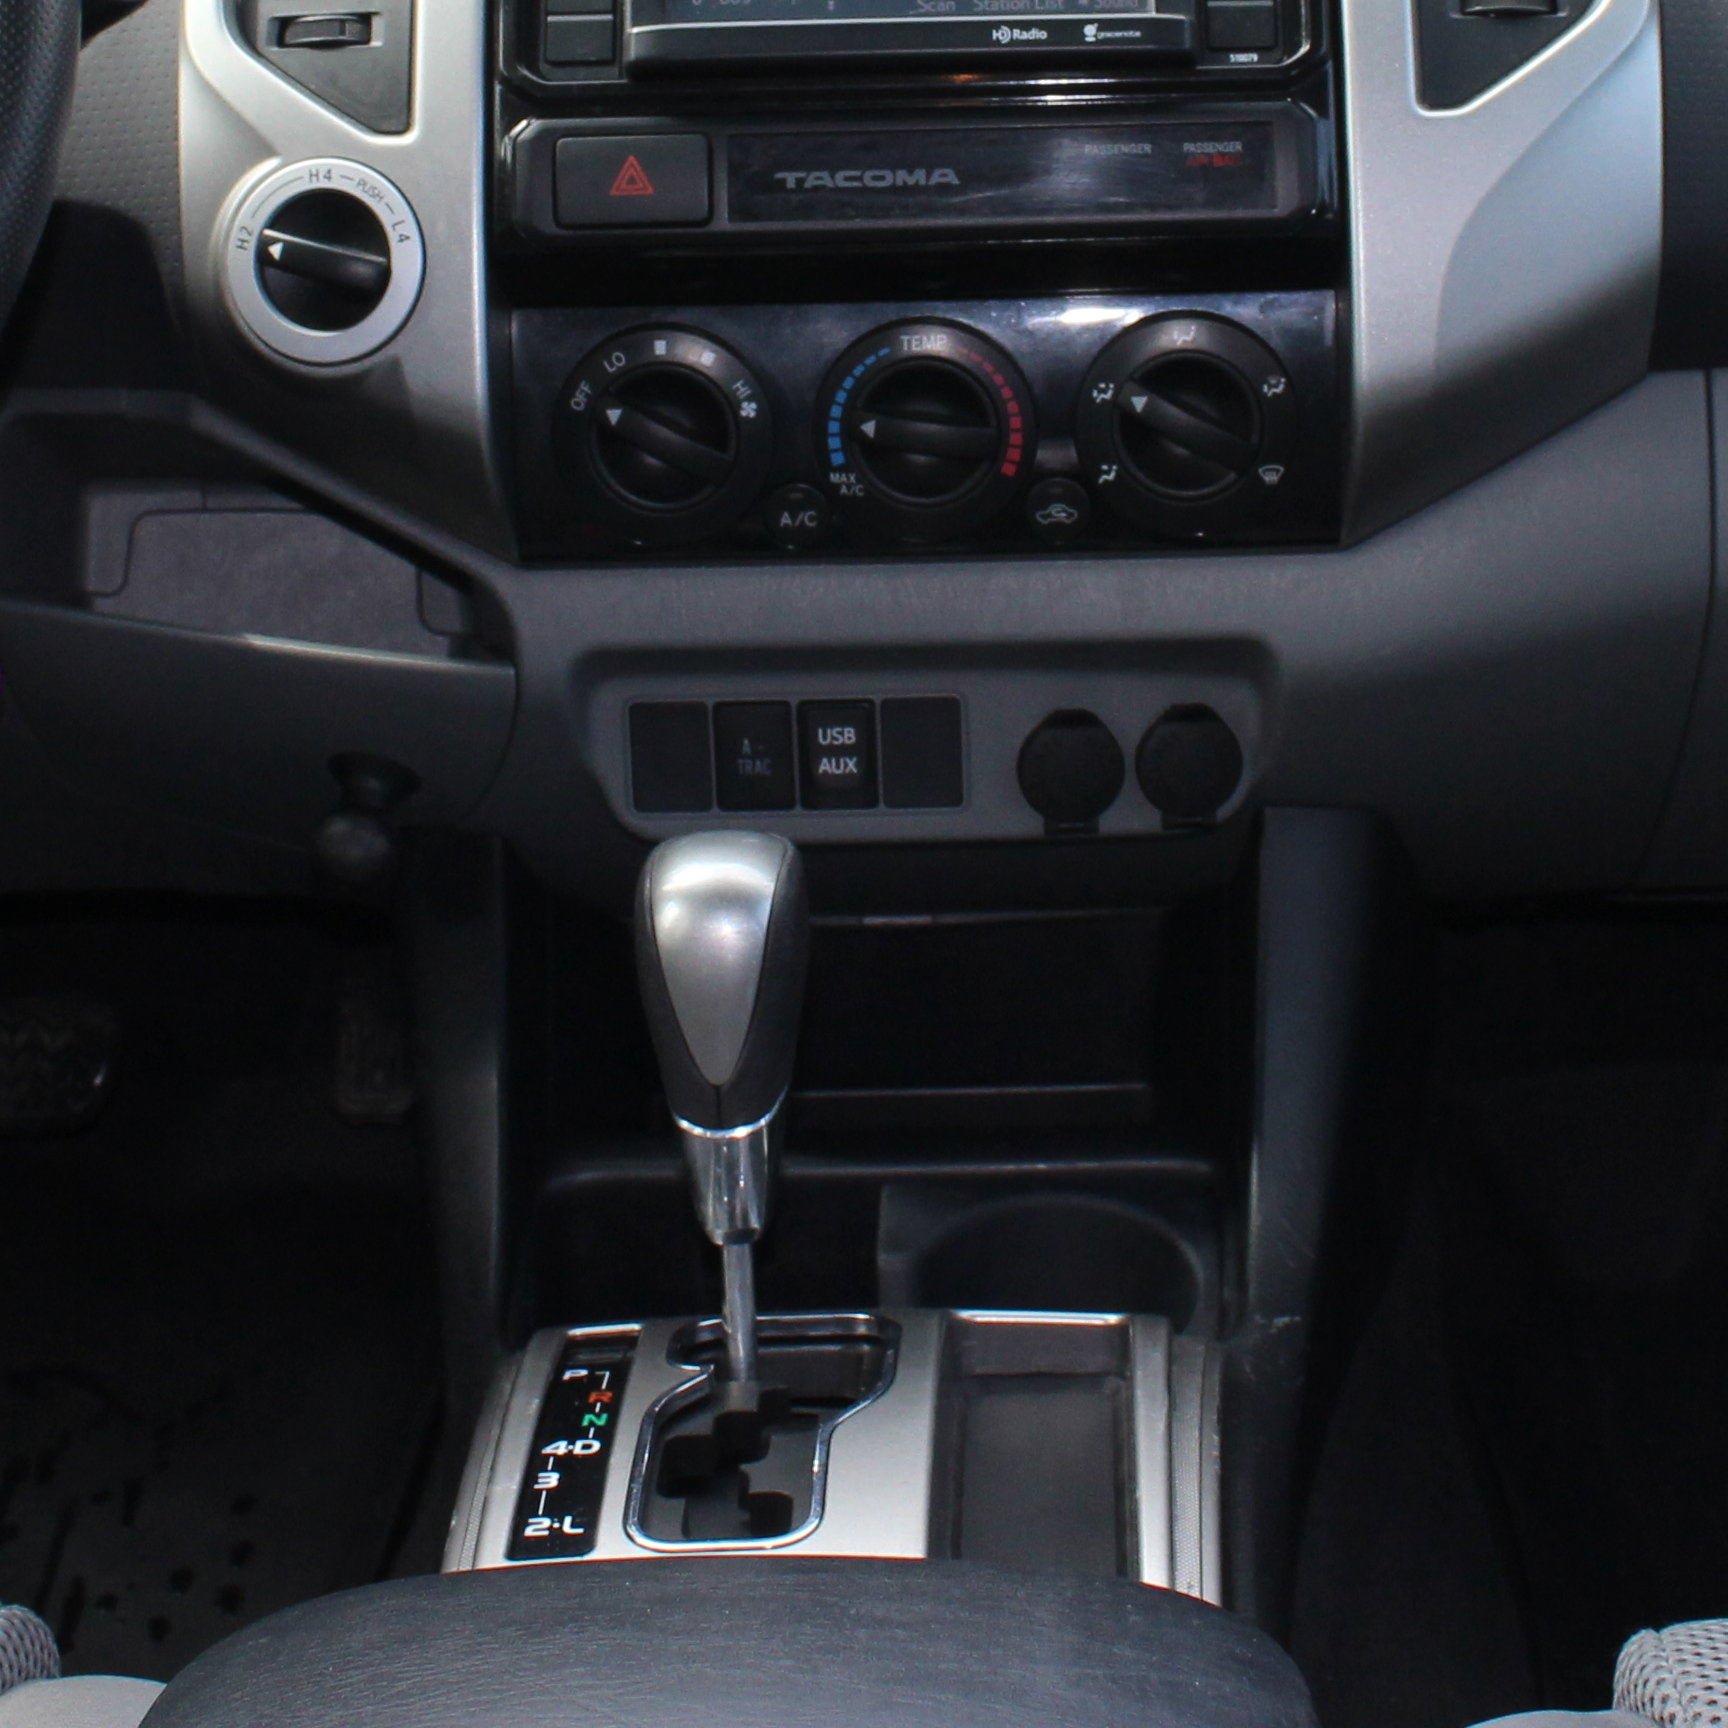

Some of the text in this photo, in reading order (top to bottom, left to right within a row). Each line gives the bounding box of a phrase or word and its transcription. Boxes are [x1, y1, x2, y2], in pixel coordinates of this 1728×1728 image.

[1012, 28, 1048, 41] Radio
[1084, 143, 1152, 155] PASSENGER
[1183, 142, 1243, 153] PASSENGER
[774, 168, 961, 189] TACOMA
[356, 178, 385, 203] PUSH
[899, 334, 948, 351] TEMP
[603, 351, 626, 373] LO
[570, 380, 592, 411] OFF
[732, 379, 752, 399] HI
[829, 472, 856, 484] MAX
[840, 484, 864, 496] A/C
[780, 510, 817, 527] A/C
[818, 727, 856, 745] USB
[818, 757, 858, 774] AUX
[562, 1369, 589, 1381] P
[588, 1391, 614, 1403] R
[581, 1413, 608, 1427] N
[533, 1471, 561, 1490] 3
